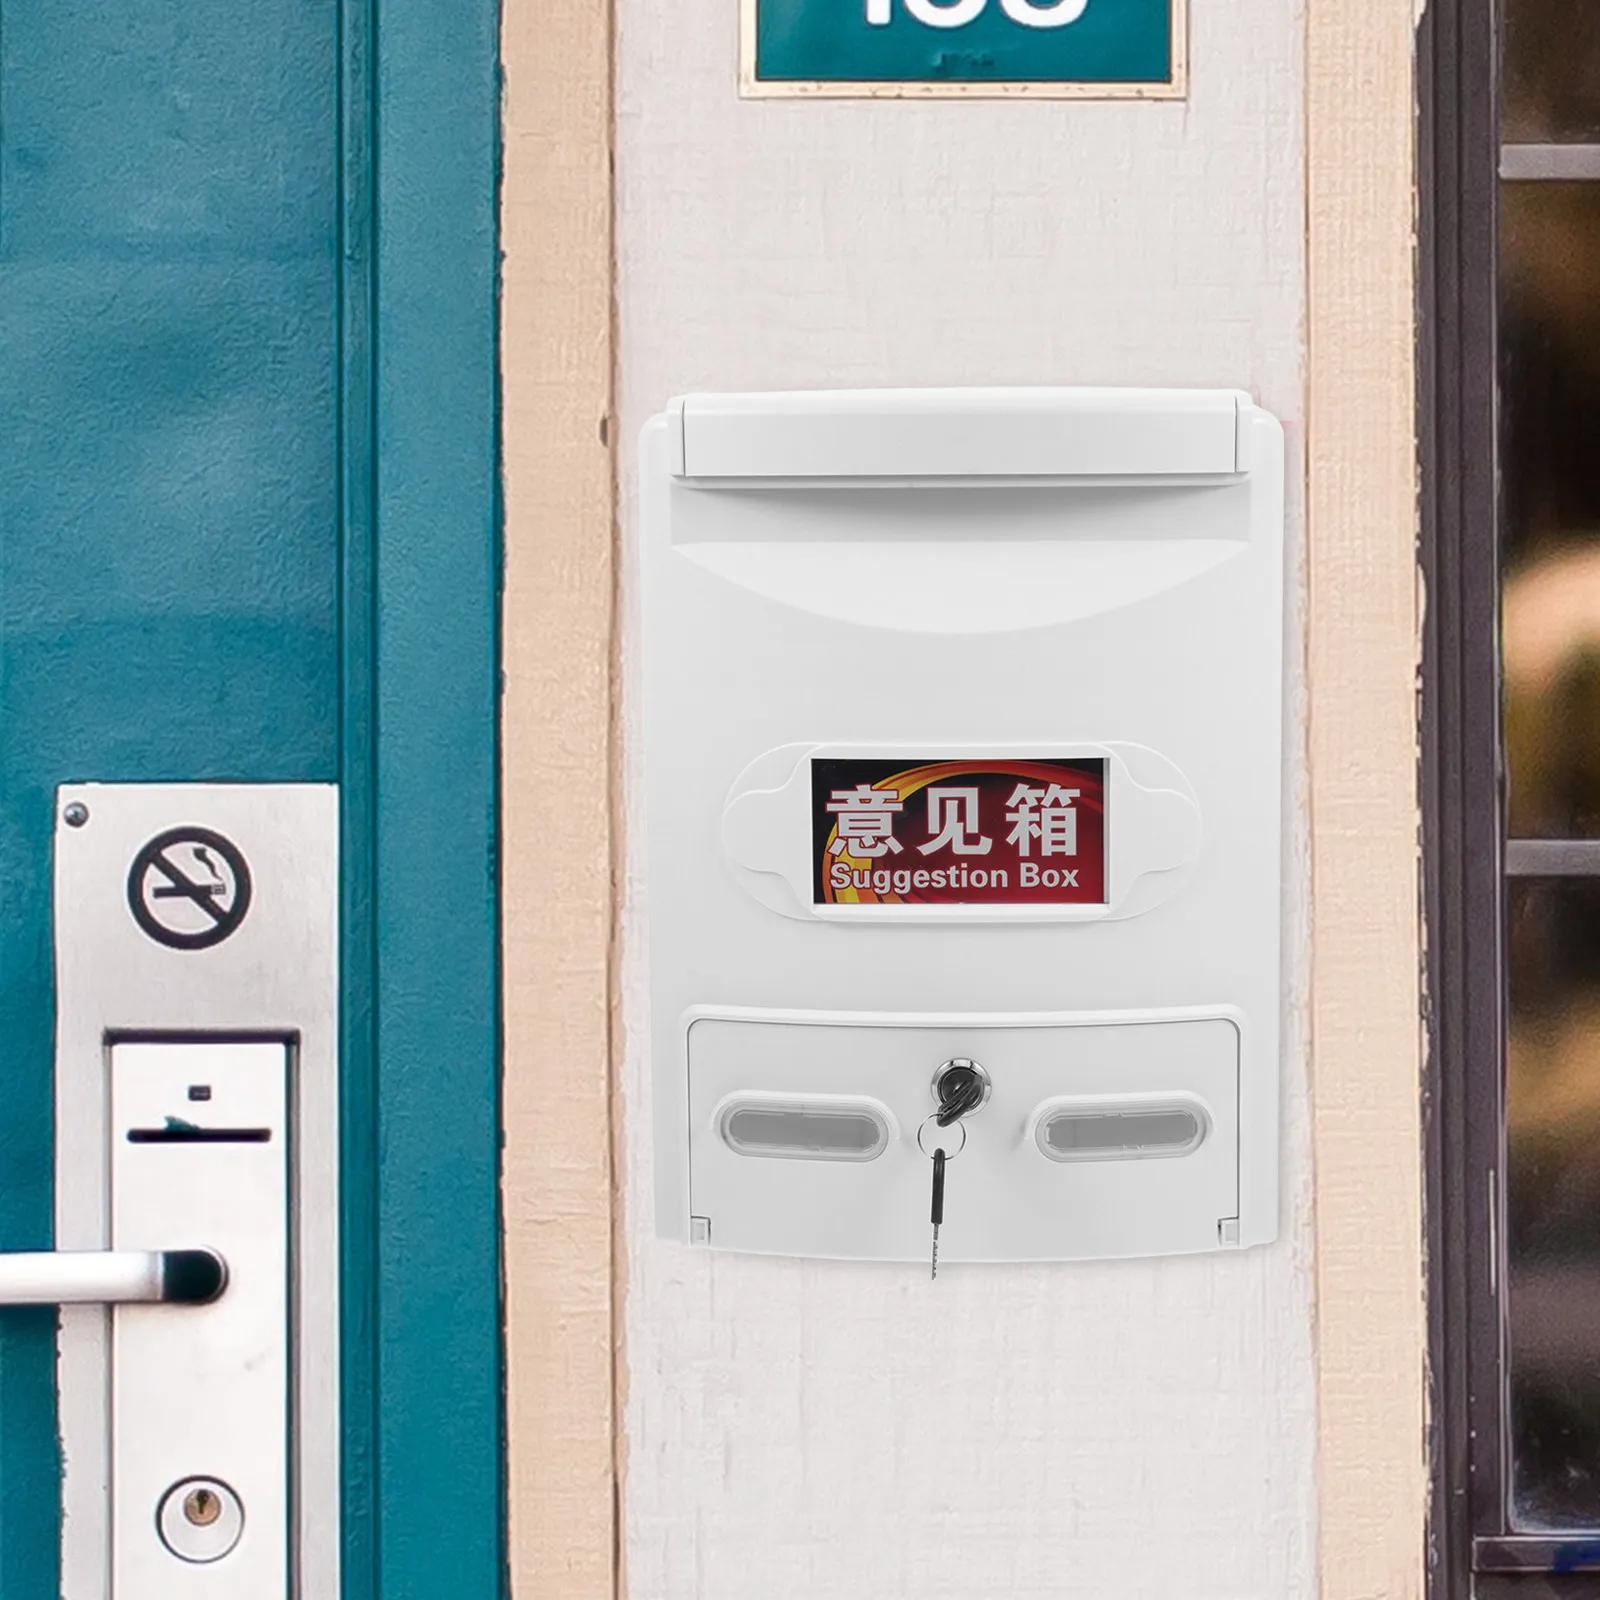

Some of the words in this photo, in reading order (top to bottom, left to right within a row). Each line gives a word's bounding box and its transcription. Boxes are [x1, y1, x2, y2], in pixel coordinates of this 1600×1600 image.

[826, 784, 1080, 857] 意见箱
[830, 863, 1008, 894] Suggestion
[1019, 863, 1079, 888] Box
